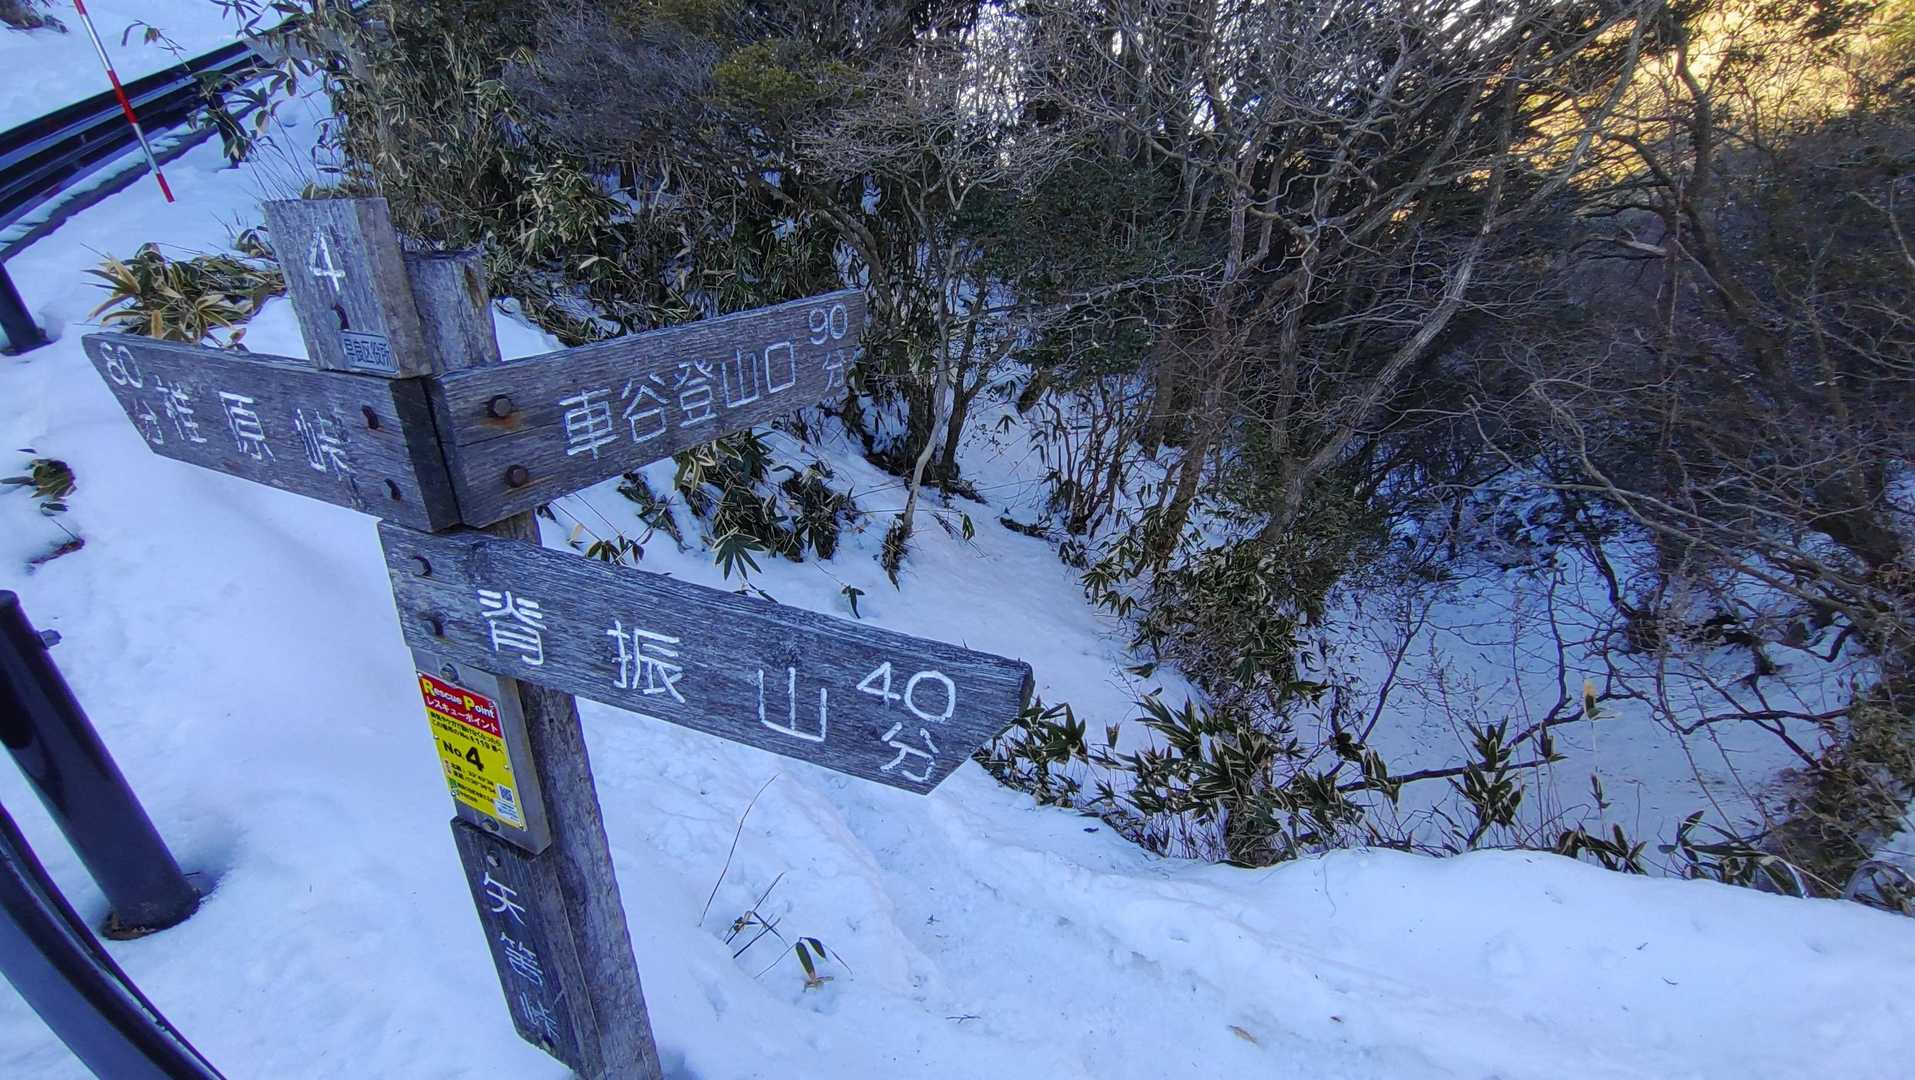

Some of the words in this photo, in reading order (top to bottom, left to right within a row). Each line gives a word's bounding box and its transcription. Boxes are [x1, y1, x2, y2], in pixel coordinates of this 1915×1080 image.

[308, 227, 346, 292] 4
[808, 303, 849, 345] 90
[344, 338, 391, 368] 早良区役所
[822, 350, 846, 393] 分
[133, 399, 164, 445] 分
[559, 341, 796, 460] 車谷登山口
[477, 588, 828, 743] 脊振山
[856, 660, 956, 723] 40
[420, 677, 463, 705] Rescue
[463, 695, 495, 718] Point
[426, 695, 498, 733] レスキューポイント
[879, 721, 939, 783] 分
[483, 871, 561, 1040] 矢筈峠
